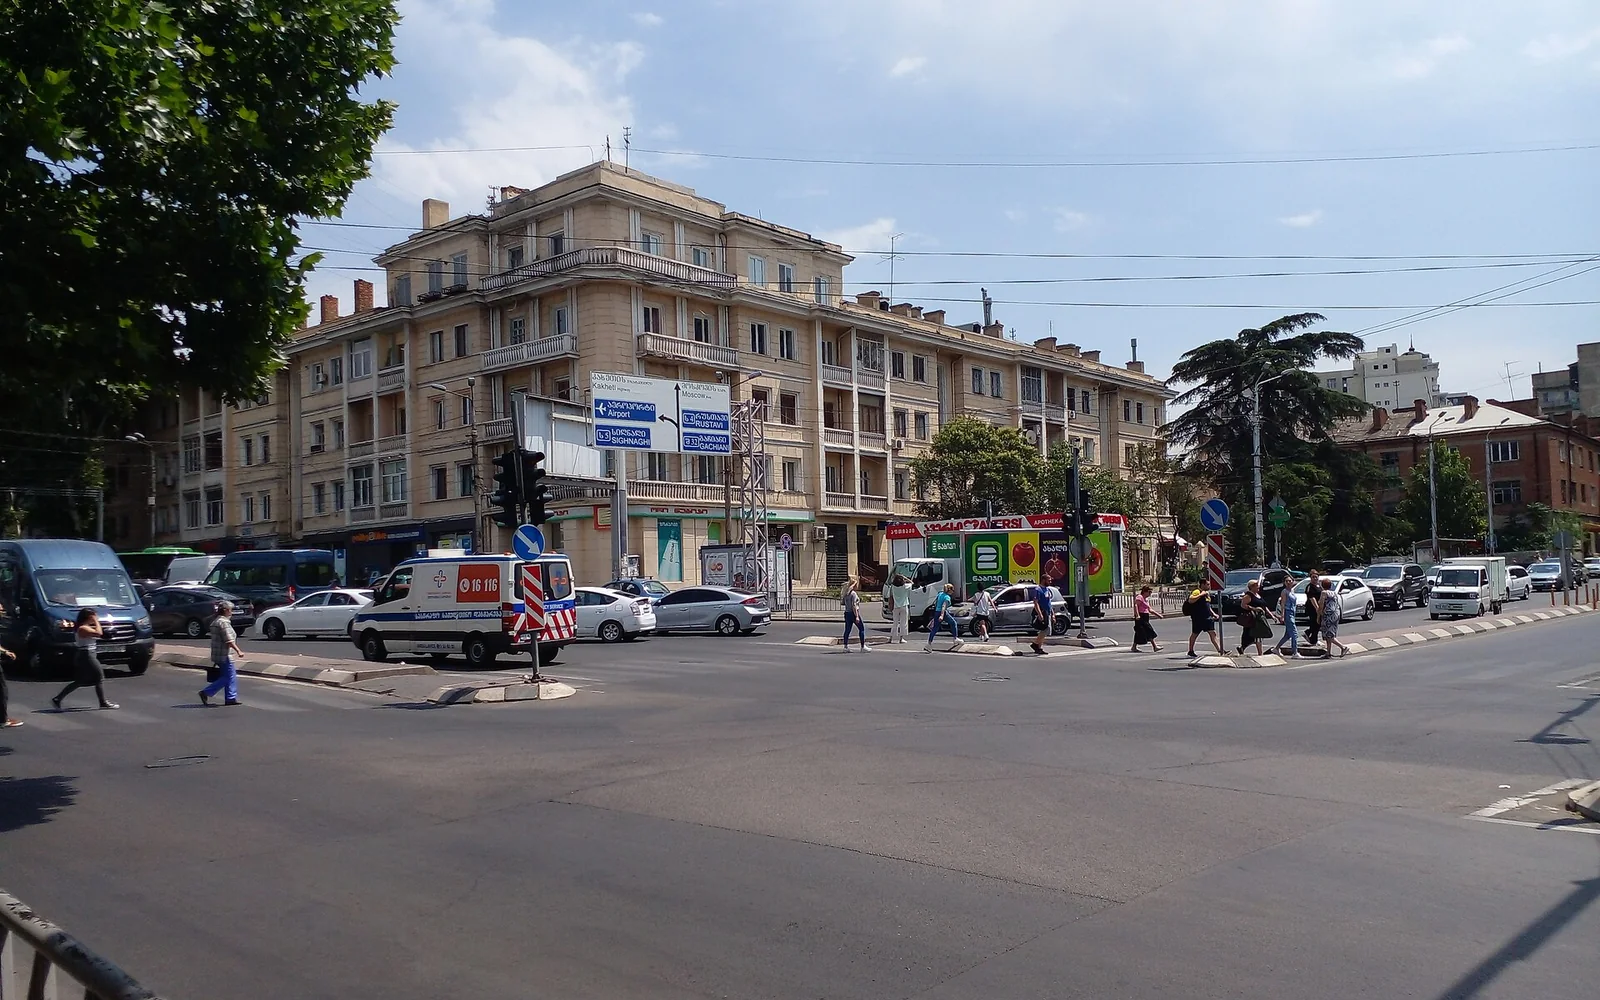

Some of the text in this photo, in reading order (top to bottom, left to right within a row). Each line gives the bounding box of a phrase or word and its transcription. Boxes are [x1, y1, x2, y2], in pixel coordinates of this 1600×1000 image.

[593, 382, 617, 391] Kakheti
[681, 390, 706, 399] Moscow
[607, 401, 655, 412] აეროპორტი
[608, 409, 631, 419] Airport
[695, 412, 728, 422] რუსთავი
[695, 420, 724, 429] RUSTAVI
[611, 429, 646, 438] სიღნაღი
[611, 436, 651, 446] SIGHNAGHI
[699, 442, 729, 451] GACHIANI
[1034, 518, 1064, 526] APOTHEKA
[972, 575, 1003, 583] ნაბიჯი
[471, 578, 498, 592] 16 116
